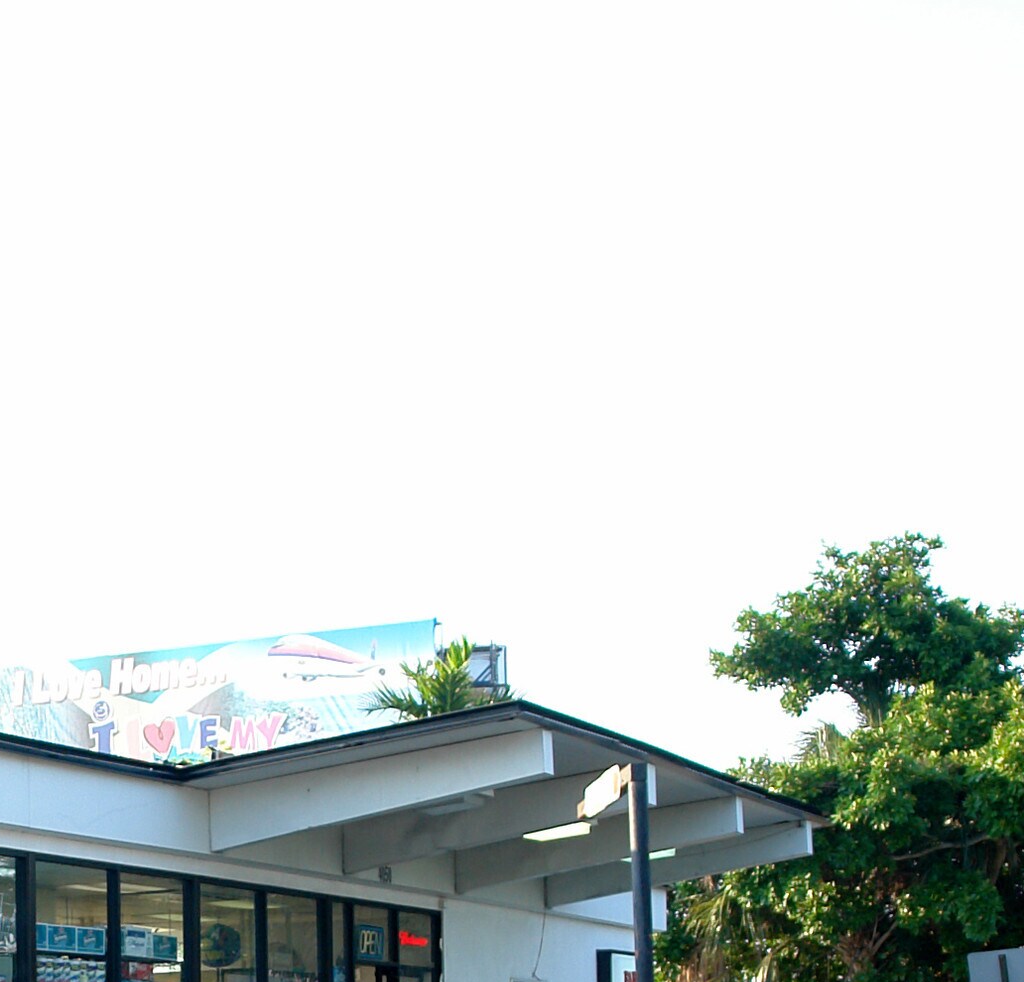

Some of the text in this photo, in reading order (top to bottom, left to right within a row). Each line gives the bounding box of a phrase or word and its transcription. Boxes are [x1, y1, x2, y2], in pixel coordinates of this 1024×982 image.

[32, 667, 103, 705] Love
[230, 714, 283, 749] MY
[359, 930, 383, 954] OPEN
